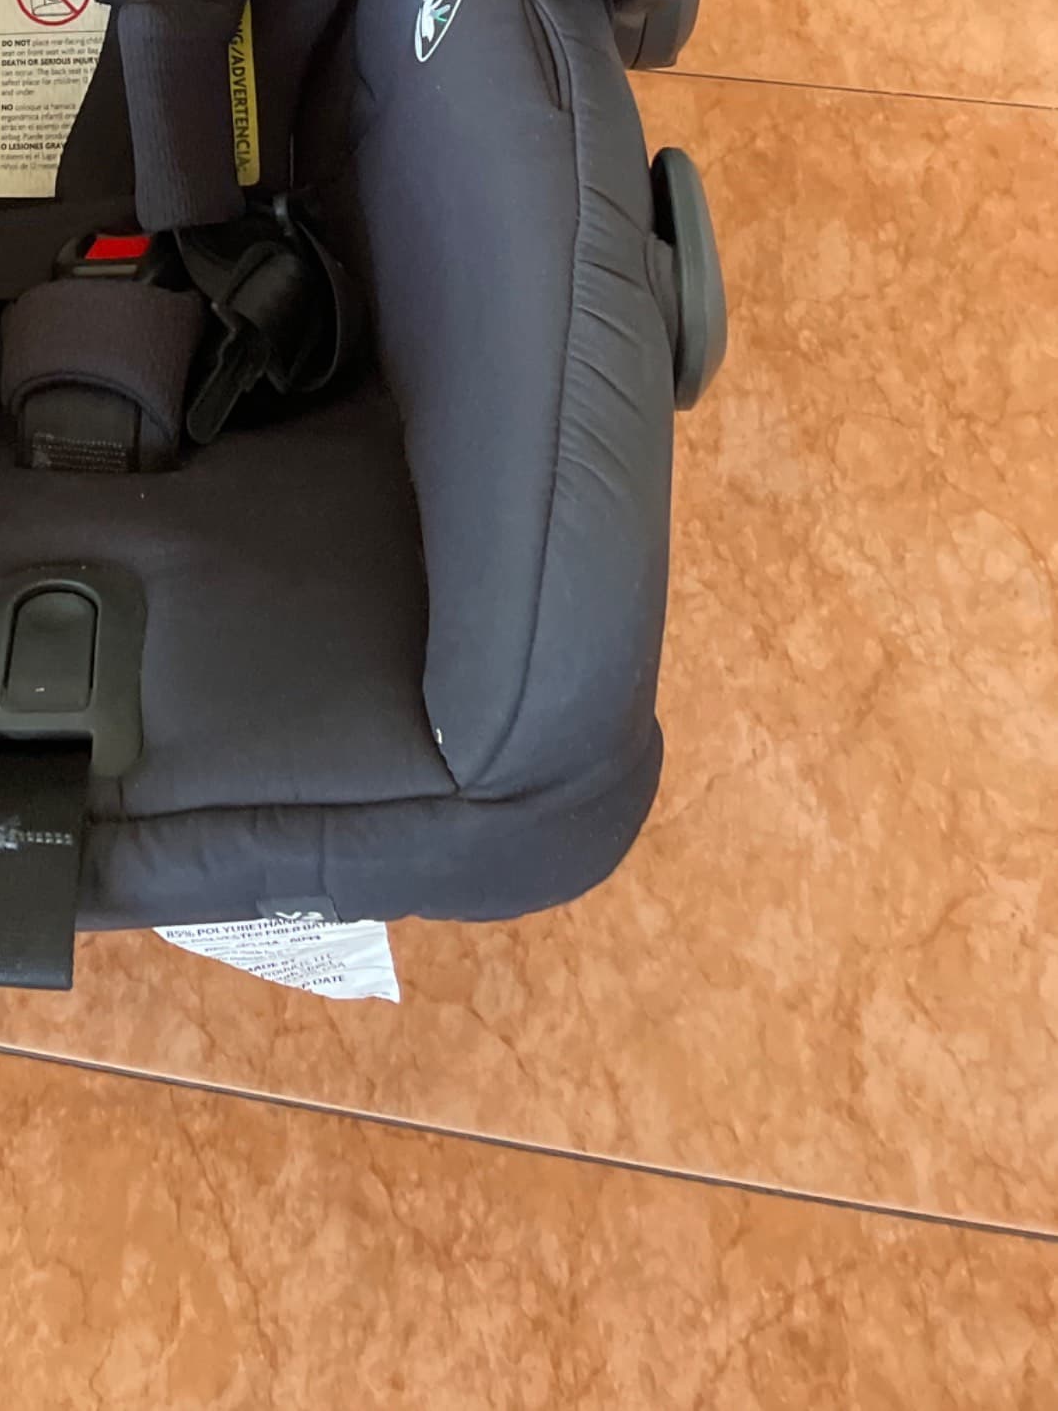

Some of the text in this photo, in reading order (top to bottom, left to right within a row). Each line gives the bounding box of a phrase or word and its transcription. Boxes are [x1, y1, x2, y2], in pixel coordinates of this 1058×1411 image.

[14, 39, 31, 47] NOT
[1, 58, 26, 67] DEATH
[27, 58, 39, 66] OR
[40, 57, 71, 66] SERIOUS
